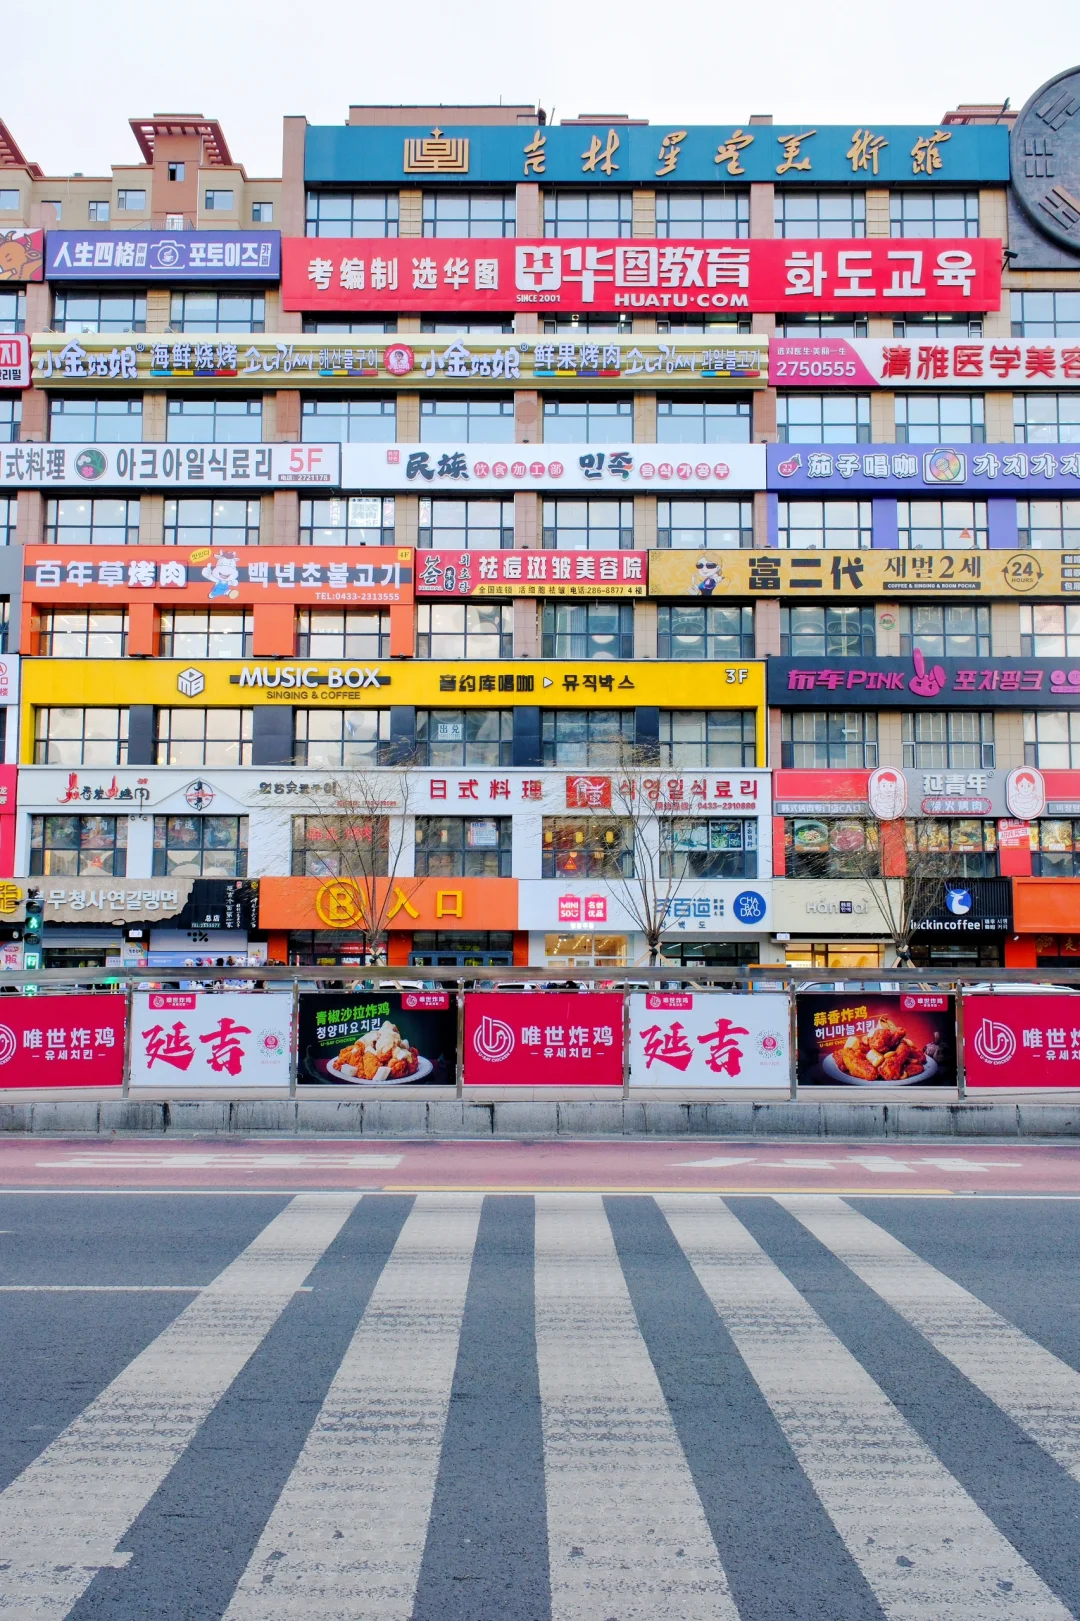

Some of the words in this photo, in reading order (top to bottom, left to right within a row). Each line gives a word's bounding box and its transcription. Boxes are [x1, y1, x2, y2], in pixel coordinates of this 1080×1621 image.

[53, 242, 134, 267] 人生四格
[189, 243, 258, 267] 포토이즈
[307, 257, 398, 290] 考编制
[412, 257, 499, 290] 选华图
[784, 249, 976, 298] 화도교육
[516, 294, 538, 302] SINCE
[539, 294, 561, 302] 2001
[37, 338, 138, 379] 小金姑娘
[150, 342, 238, 369] 海鲜烧烤
[242, 343, 314, 374] 소녀김씨
[318, 348, 378, 369] 해산물구이
[421, 338, 521, 379] 小金姑娘
[533, 342, 620, 370] 鲜果烤肉
[625, 344, 696, 375] 소녀김씨
[701, 349, 761, 371] 과일불고기
[776, 361, 856, 378] 2750555
[5, 448, 66, 481] 式料理
[116, 448, 273, 481] 아크아일식료리
[289, 448, 324, 472] 5F
[405, 451, 471, 480] 民族
[473, 461, 564, 478] 饮食加工部
[579, 451, 633, 480] 민족
[639, 462, 730, 480] 음식가공부
[807, 453, 919, 478] 茄子唱咖
[35, 559, 187, 588] 百年草烤肉
[248, 561, 401, 589] 백년초불고기
[478, 556, 642, 580] 祛痘斑皱美容院
[748, 556, 864, 590] 富二代
[1012, 561, 1034, 577] 24
[315, 592, 400, 601] TEL:0433-2313555
[478, 586, 513, 594] 全国连锁
[240, 667, 318, 687] MUSIC
[327, 667, 380, 687] BOX
[562, 675, 635, 692] 뮤직박스
[725, 669, 749, 683] 3F
[953, 670, 1043, 690] 포차핑크
[266, 691, 309, 699] SINGING
[311, 691, 318, 699] &
[320, 691, 361, 699] COFFEE
[430, 778, 542, 800] 日式料理
[386, 886, 463, 918] 入口
[588, 901, 604, 909] 名创
[739, 897, 759, 905] CHA
[740, 908, 761, 917] DAO
[205, 914, 220, 922] 总店
[316, 1002, 390, 1026] 青椒沙拉炸鸡
[813, 1005, 868, 1027] 蒜香炸鸡
[23, 1028, 115, 1049] 唯世炸鸡
[316, 1017, 381, 1040] 청양마요치킨
[521, 1025, 614, 1047] 唯世炸鸡
[45, 1050, 94, 1061] 유세치킨
[141, 1017, 252, 1076] 延吉
[543, 1047, 592, 1058] 유세치킨
[639, 1018, 750, 1078] 延吉
